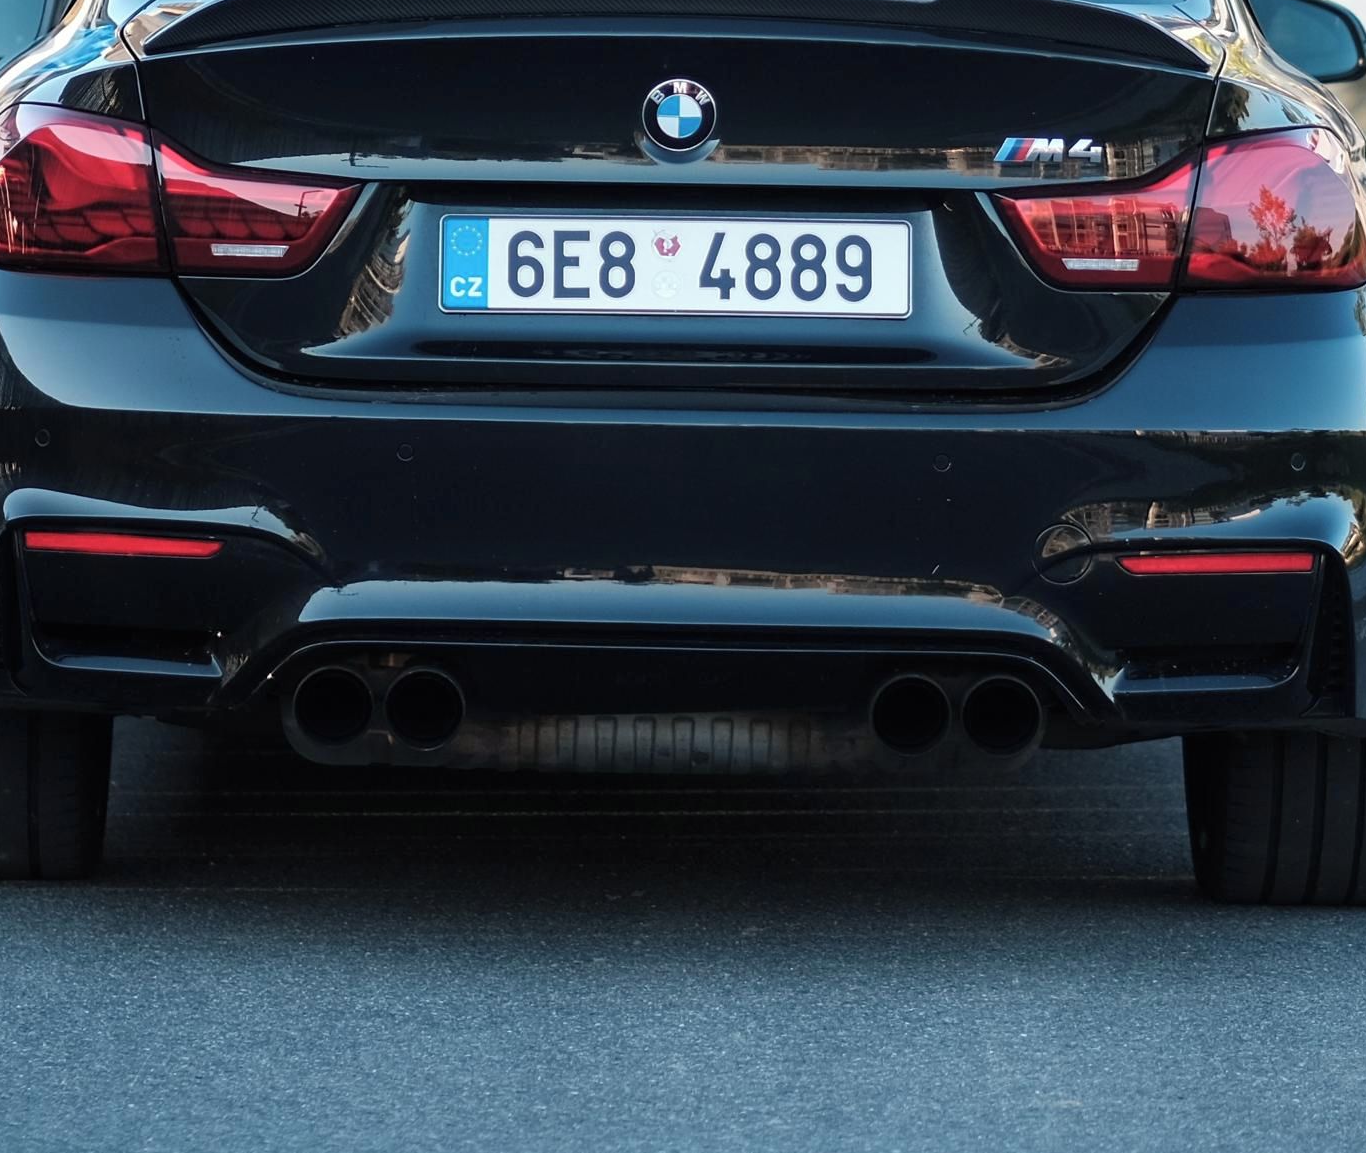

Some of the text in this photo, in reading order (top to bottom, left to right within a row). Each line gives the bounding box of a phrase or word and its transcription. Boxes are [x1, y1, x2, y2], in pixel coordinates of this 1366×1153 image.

[650, 81, 711, 106] BMW
[1026, 138, 1103, 162] M4
[507, 230, 873, 302] 6E8 4889
[450, 276, 483, 297] CZ
